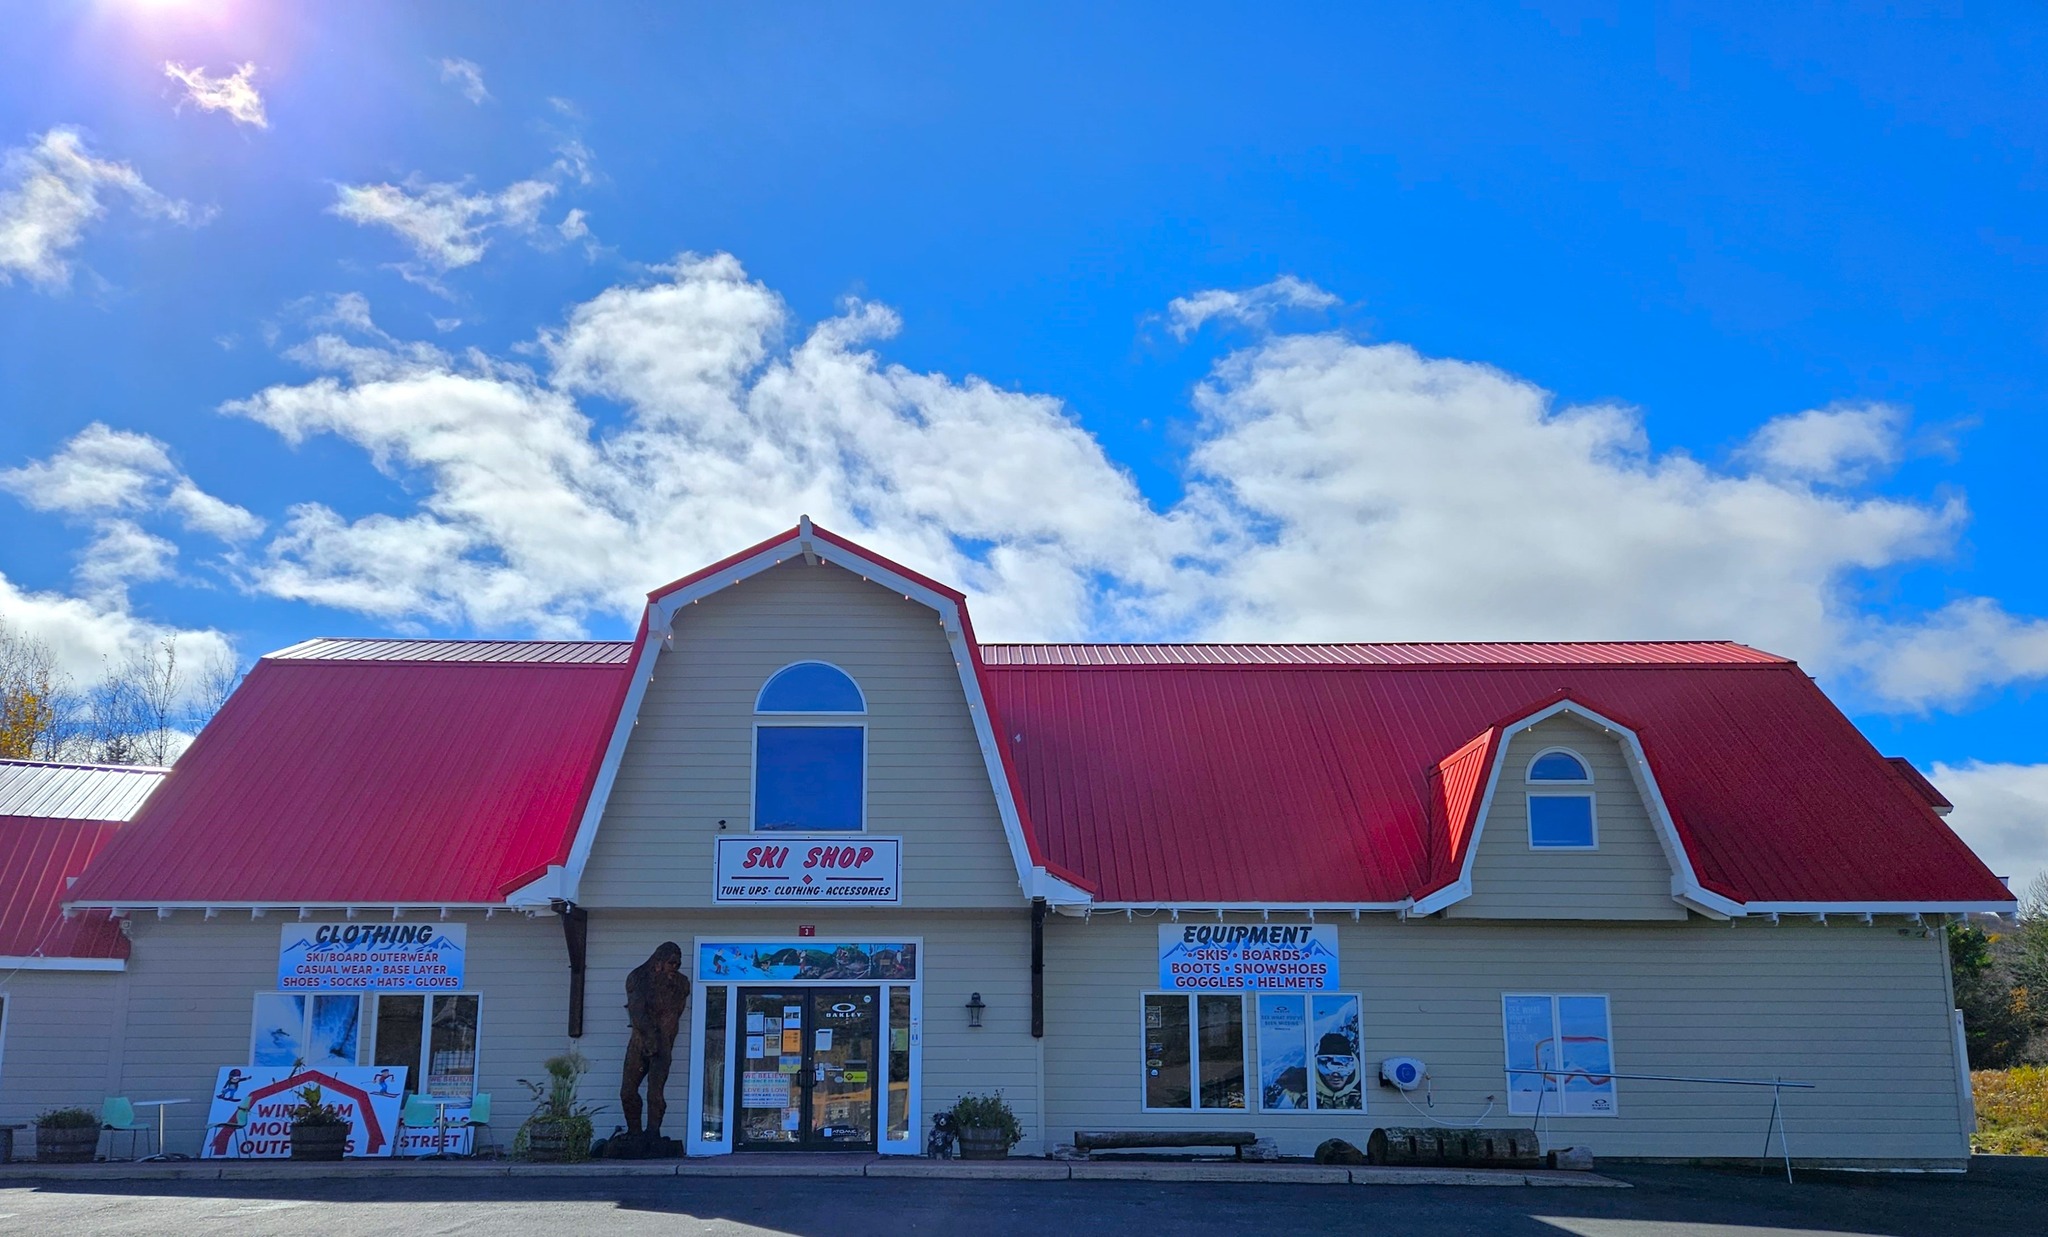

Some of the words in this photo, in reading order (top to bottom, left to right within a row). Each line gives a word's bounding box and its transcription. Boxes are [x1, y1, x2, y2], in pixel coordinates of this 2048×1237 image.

[742, 845, 790, 869] SKI
[803, 845, 874, 869] SHOP
[721, 886, 745, 896] TUNE
[774, 886, 820, 896] CLOTHING
[826, 886, 891, 896] ACCESSORIES
[316, 925, 433, 944] CLOTHING
[1183, 926, 1313, 945] EQUIPMENT
[305, 952, 367, 962] SKI/BOARD
[370, 952, 439, 962] OUTERWEAR
[1197, 950, 1229, 961] SKIS
[1242, 950, 1300, 961] BOARDS
[296, 965, 339, 975] CASUAL
[341, 965, 373, 975] WEAR
[383, 965, 410, 975] BASE
[413, 965, 447, 975] LAYER
[1172, 963, 1221, 974] BOOTS
[1234, 963, 1327, 974] SNOWSHOES
[283, 977, 320, 987] SHOES
[330, 977, 367, 987] SOCKS
[377, 977, 405, 987] HATS
[415, 977, 458, 987] GLOVES
[1176, 976, 1244, 988] GOGGLES
[1257, 976, 1324, 988] HELMETS
[399, 1134, 461, 1148] STREET
